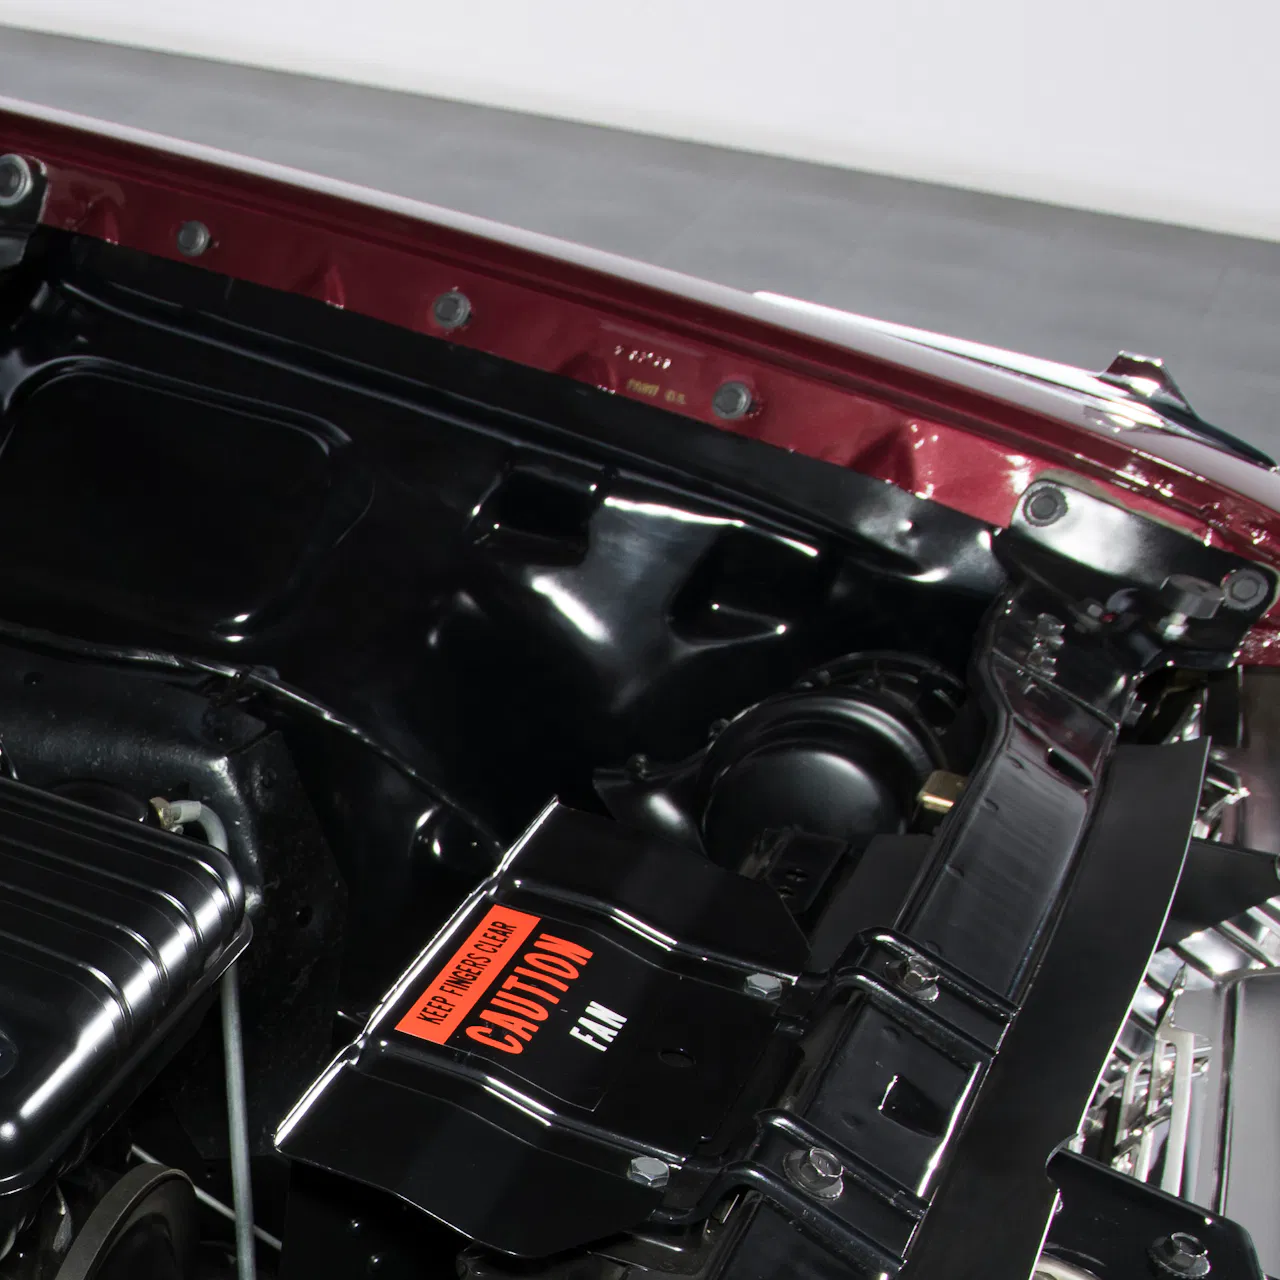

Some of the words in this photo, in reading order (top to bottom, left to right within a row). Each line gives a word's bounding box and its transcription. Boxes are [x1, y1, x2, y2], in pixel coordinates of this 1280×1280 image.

[416, 993, 455, 1026] KEEP
[439, 951, 493, 998] FINGERS
[481, 921, 518, 955] CLEAR
[465, 933, 594, 1055] CAUTION
[569, 1000, 628, 1052] FAN
